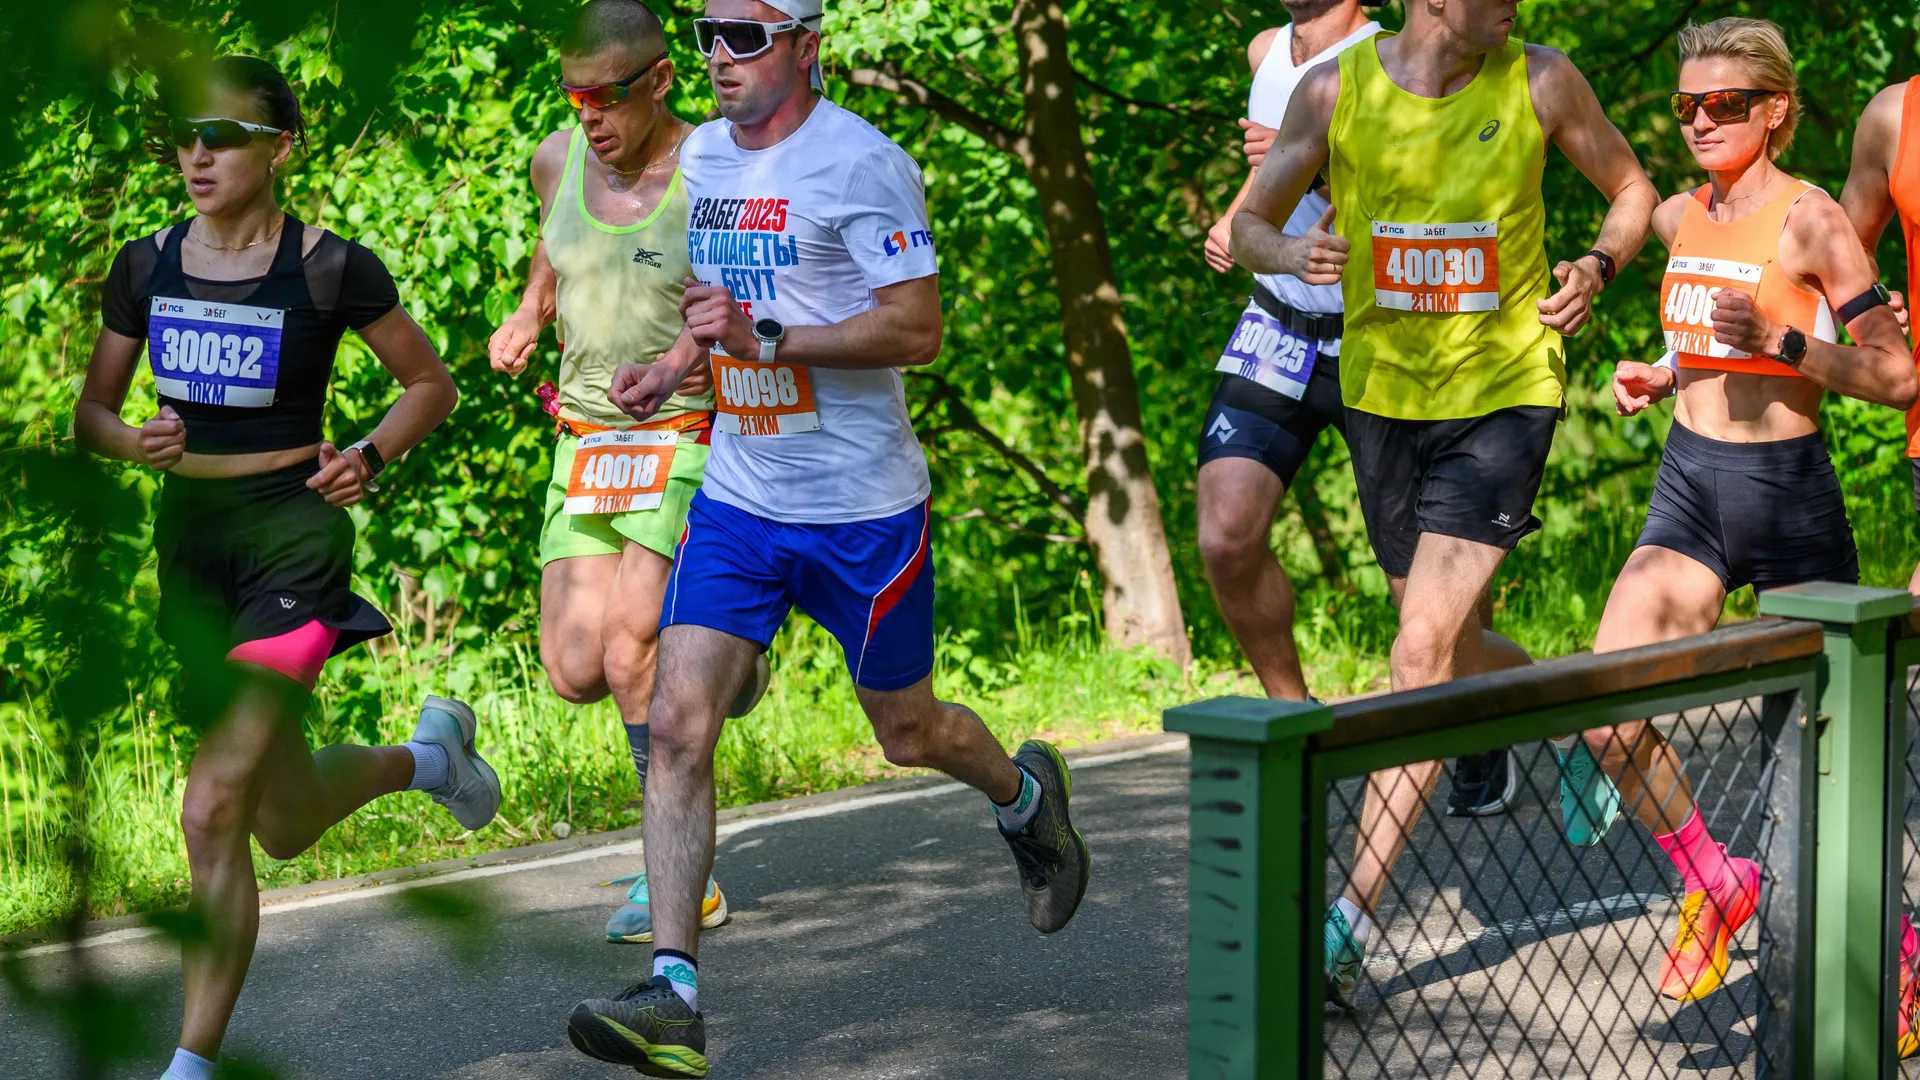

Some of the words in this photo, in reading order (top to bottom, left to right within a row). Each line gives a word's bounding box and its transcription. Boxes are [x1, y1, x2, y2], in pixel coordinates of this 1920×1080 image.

[689, 197, 790, 232] #ЗАБЕГ2025
[1389, 226, 1405, 234] ПСБ
[687, 230, 706, 265] 5%
[708, 232, 799, 267] ПЛАНЕТЫ
[1386, 247, 1484, 286] 40030
[721, 267, 776, 301] БЕГУТ
[168, 304, 184, 313] ПСБ
[1664, 282, 1722, 328] 4000
[161, 328, 263, 379] 30032
[1232, 320, 1308, 373] 30025
[721, 366, 798, 407] 40098
[580, 453, 659, 489] 40018
